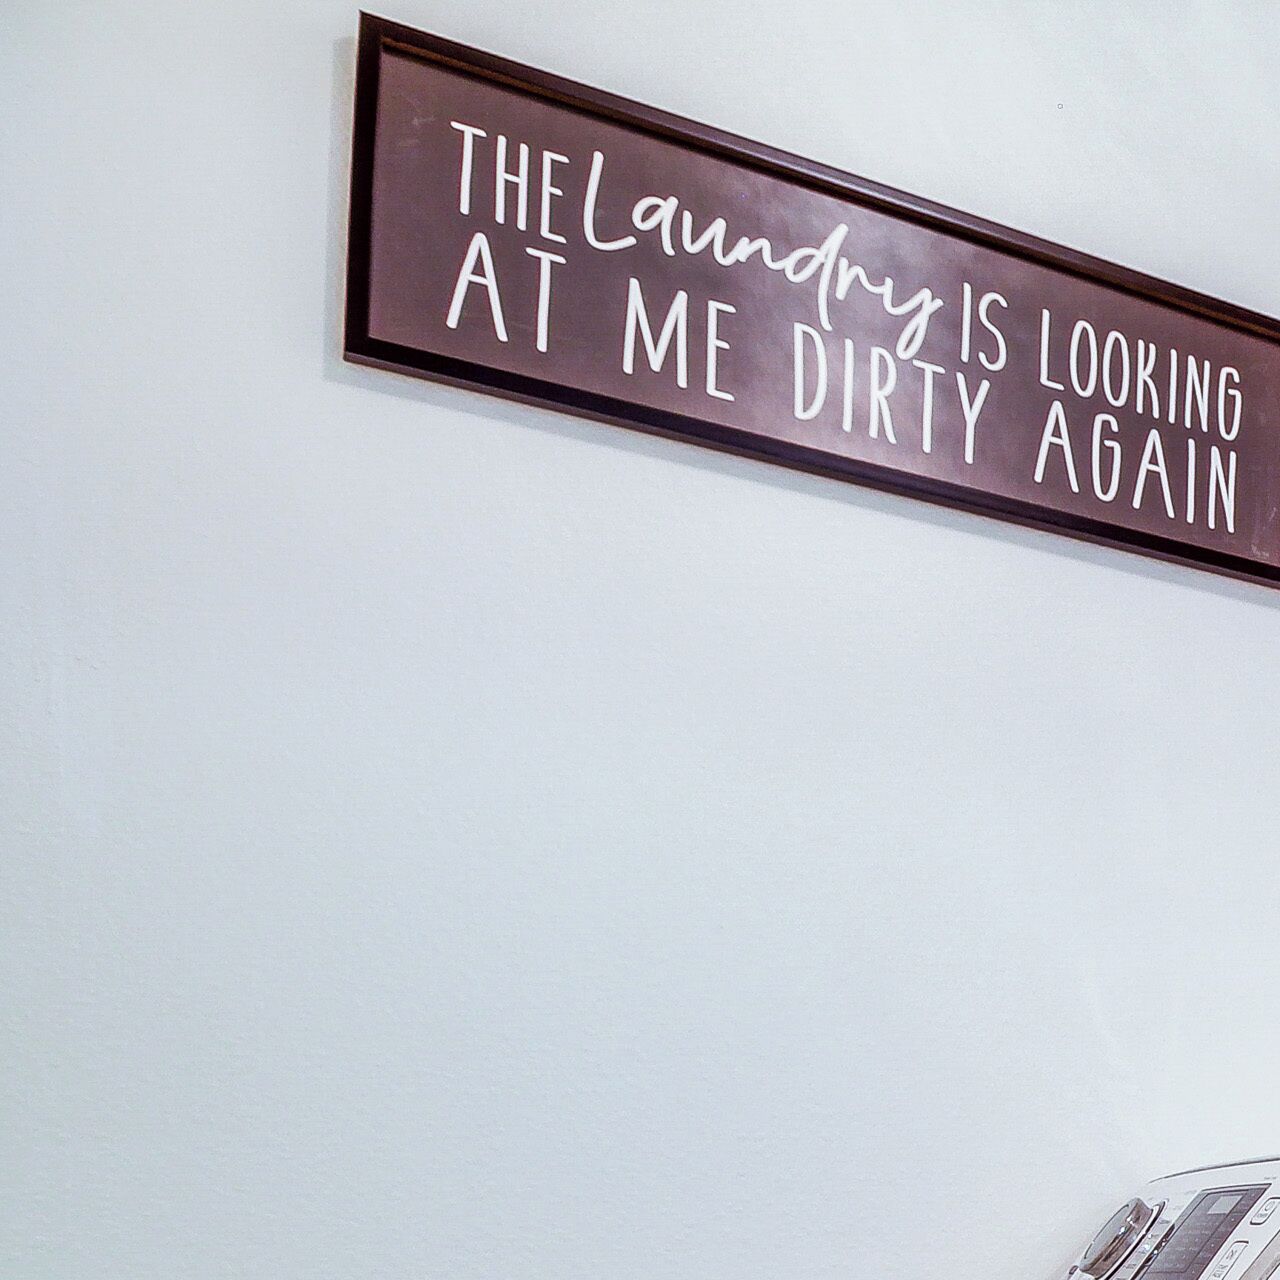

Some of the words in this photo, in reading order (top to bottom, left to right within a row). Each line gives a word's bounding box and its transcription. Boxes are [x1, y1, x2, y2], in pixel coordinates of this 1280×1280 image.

[446, 232, 566, 352] AT
[623, 278, 736, 401] ME
[794, 322, 990, 464] DIRTY
[1034, 400, 1237, 534] AGAIN
[451, 121, 569, 244] THE
[583, 151, 942, 357] Laundry
[961, 282, 1007, 372] IS
[1039, 309, 1243, 441] LOOKING
